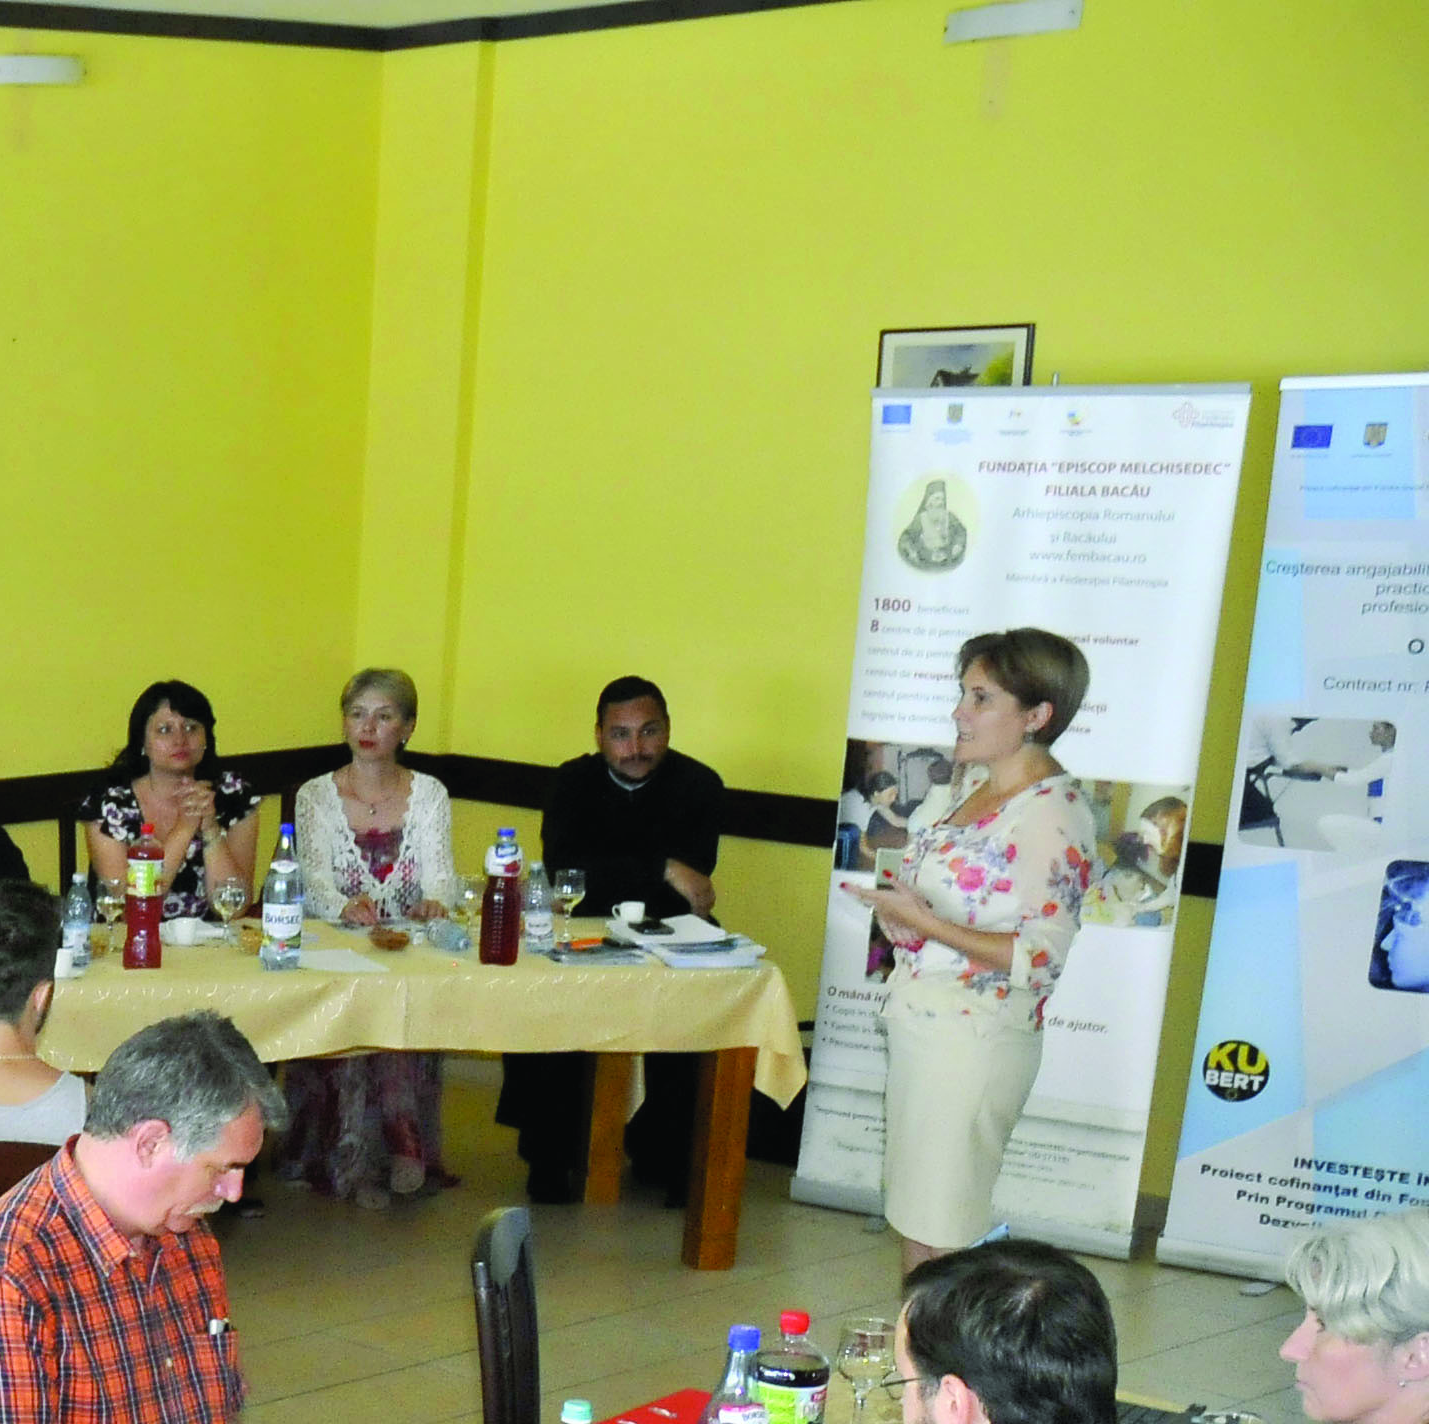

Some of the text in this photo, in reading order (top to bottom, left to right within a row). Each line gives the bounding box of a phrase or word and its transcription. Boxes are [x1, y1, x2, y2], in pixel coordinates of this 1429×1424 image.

[1045, 485, 1096, 497] FILIALA
[873, 598, 911, 612] 1800
[870, 620, 879, 633] 8
[1093, 636, 1139, 646] voluntar
[913, 671, 960, 683] recuper
[1323, 676, 1393, 692] Contract
[263, 913, 302, 925] BORSEC
[1048, 1016, 1065, 1027] de
[1208, 1043, 1268, 1075] KU
[1204, 1068, 1265, 1093] BERT
[1200, 1164, 1263, 1183] Proiect
[1364, 1187, 1393, 1204] din
[1236, 1190, 1270, 1206] Prin
